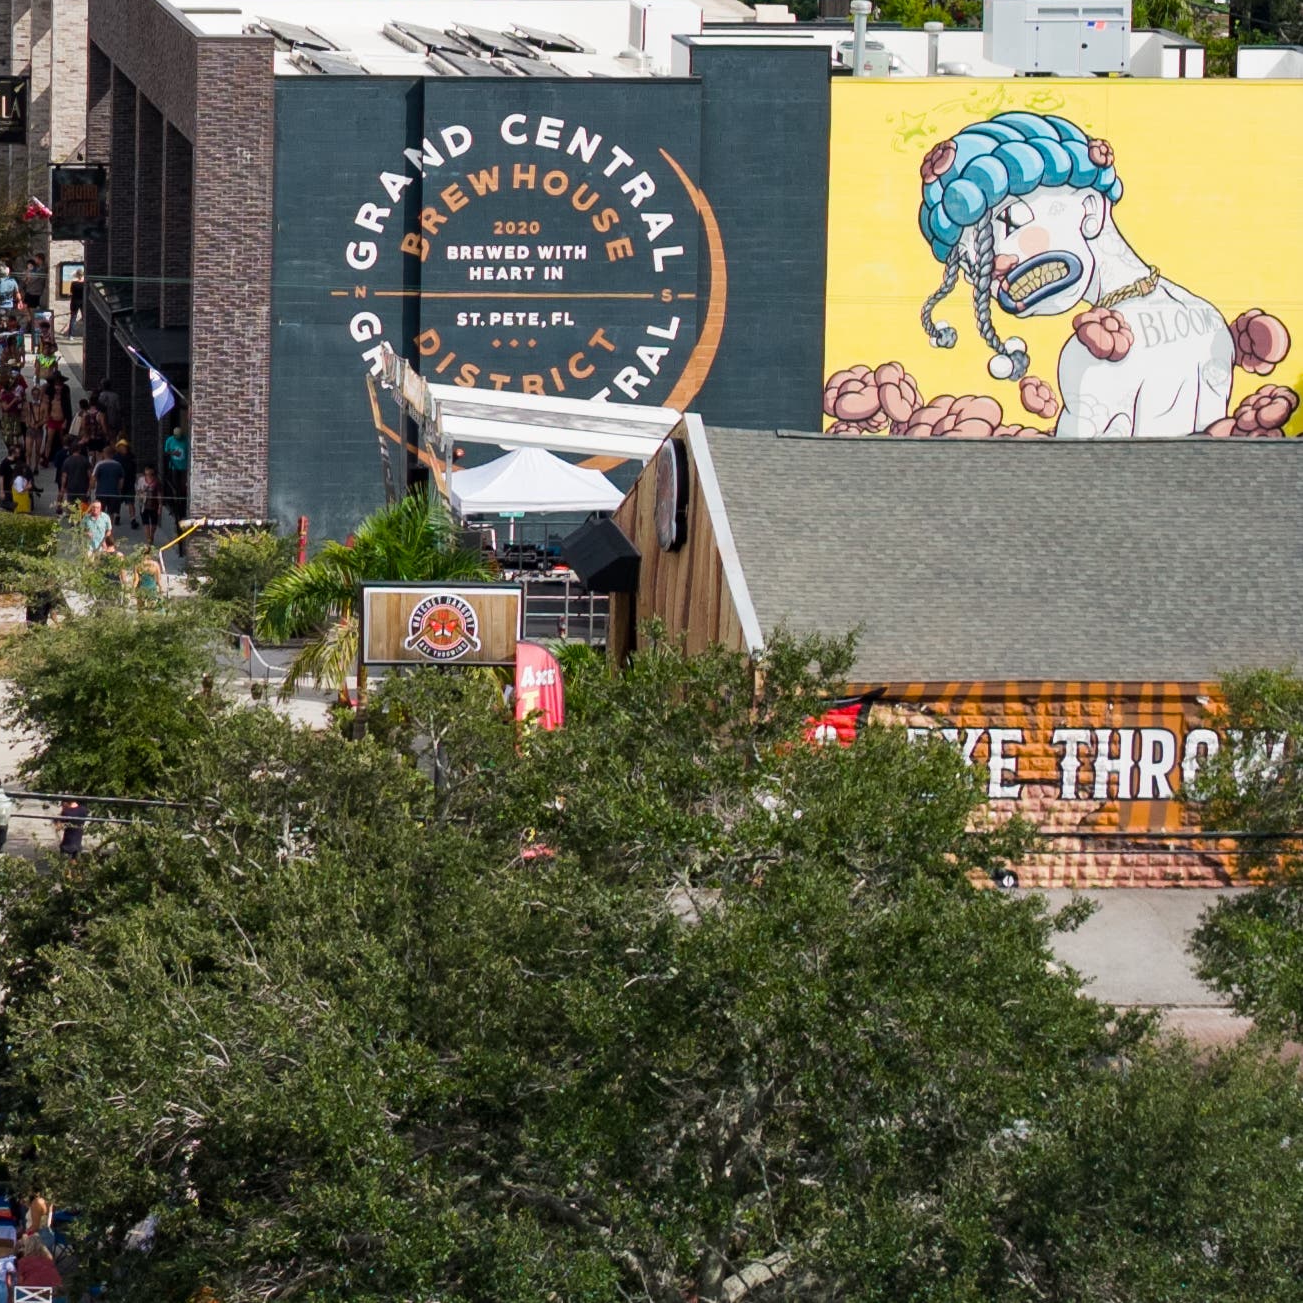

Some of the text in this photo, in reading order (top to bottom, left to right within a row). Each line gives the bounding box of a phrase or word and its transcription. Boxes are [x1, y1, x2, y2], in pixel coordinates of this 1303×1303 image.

[346, 113, 684, 273] GRAND CENTRAL
[400, 163, 634, 262] BREWHOUSE
[493, 221, 541, 235] 2020
[446, 245, 587, 260] BREWED WITH
[469, 266, 564, 281] HEART IN
[354, 286, 367, 298] N
[661, 289, 672, 302] S
[456, 312, 575, 328] ST. PETE, FL
[413, 328, 616, 395] DISTRICT
